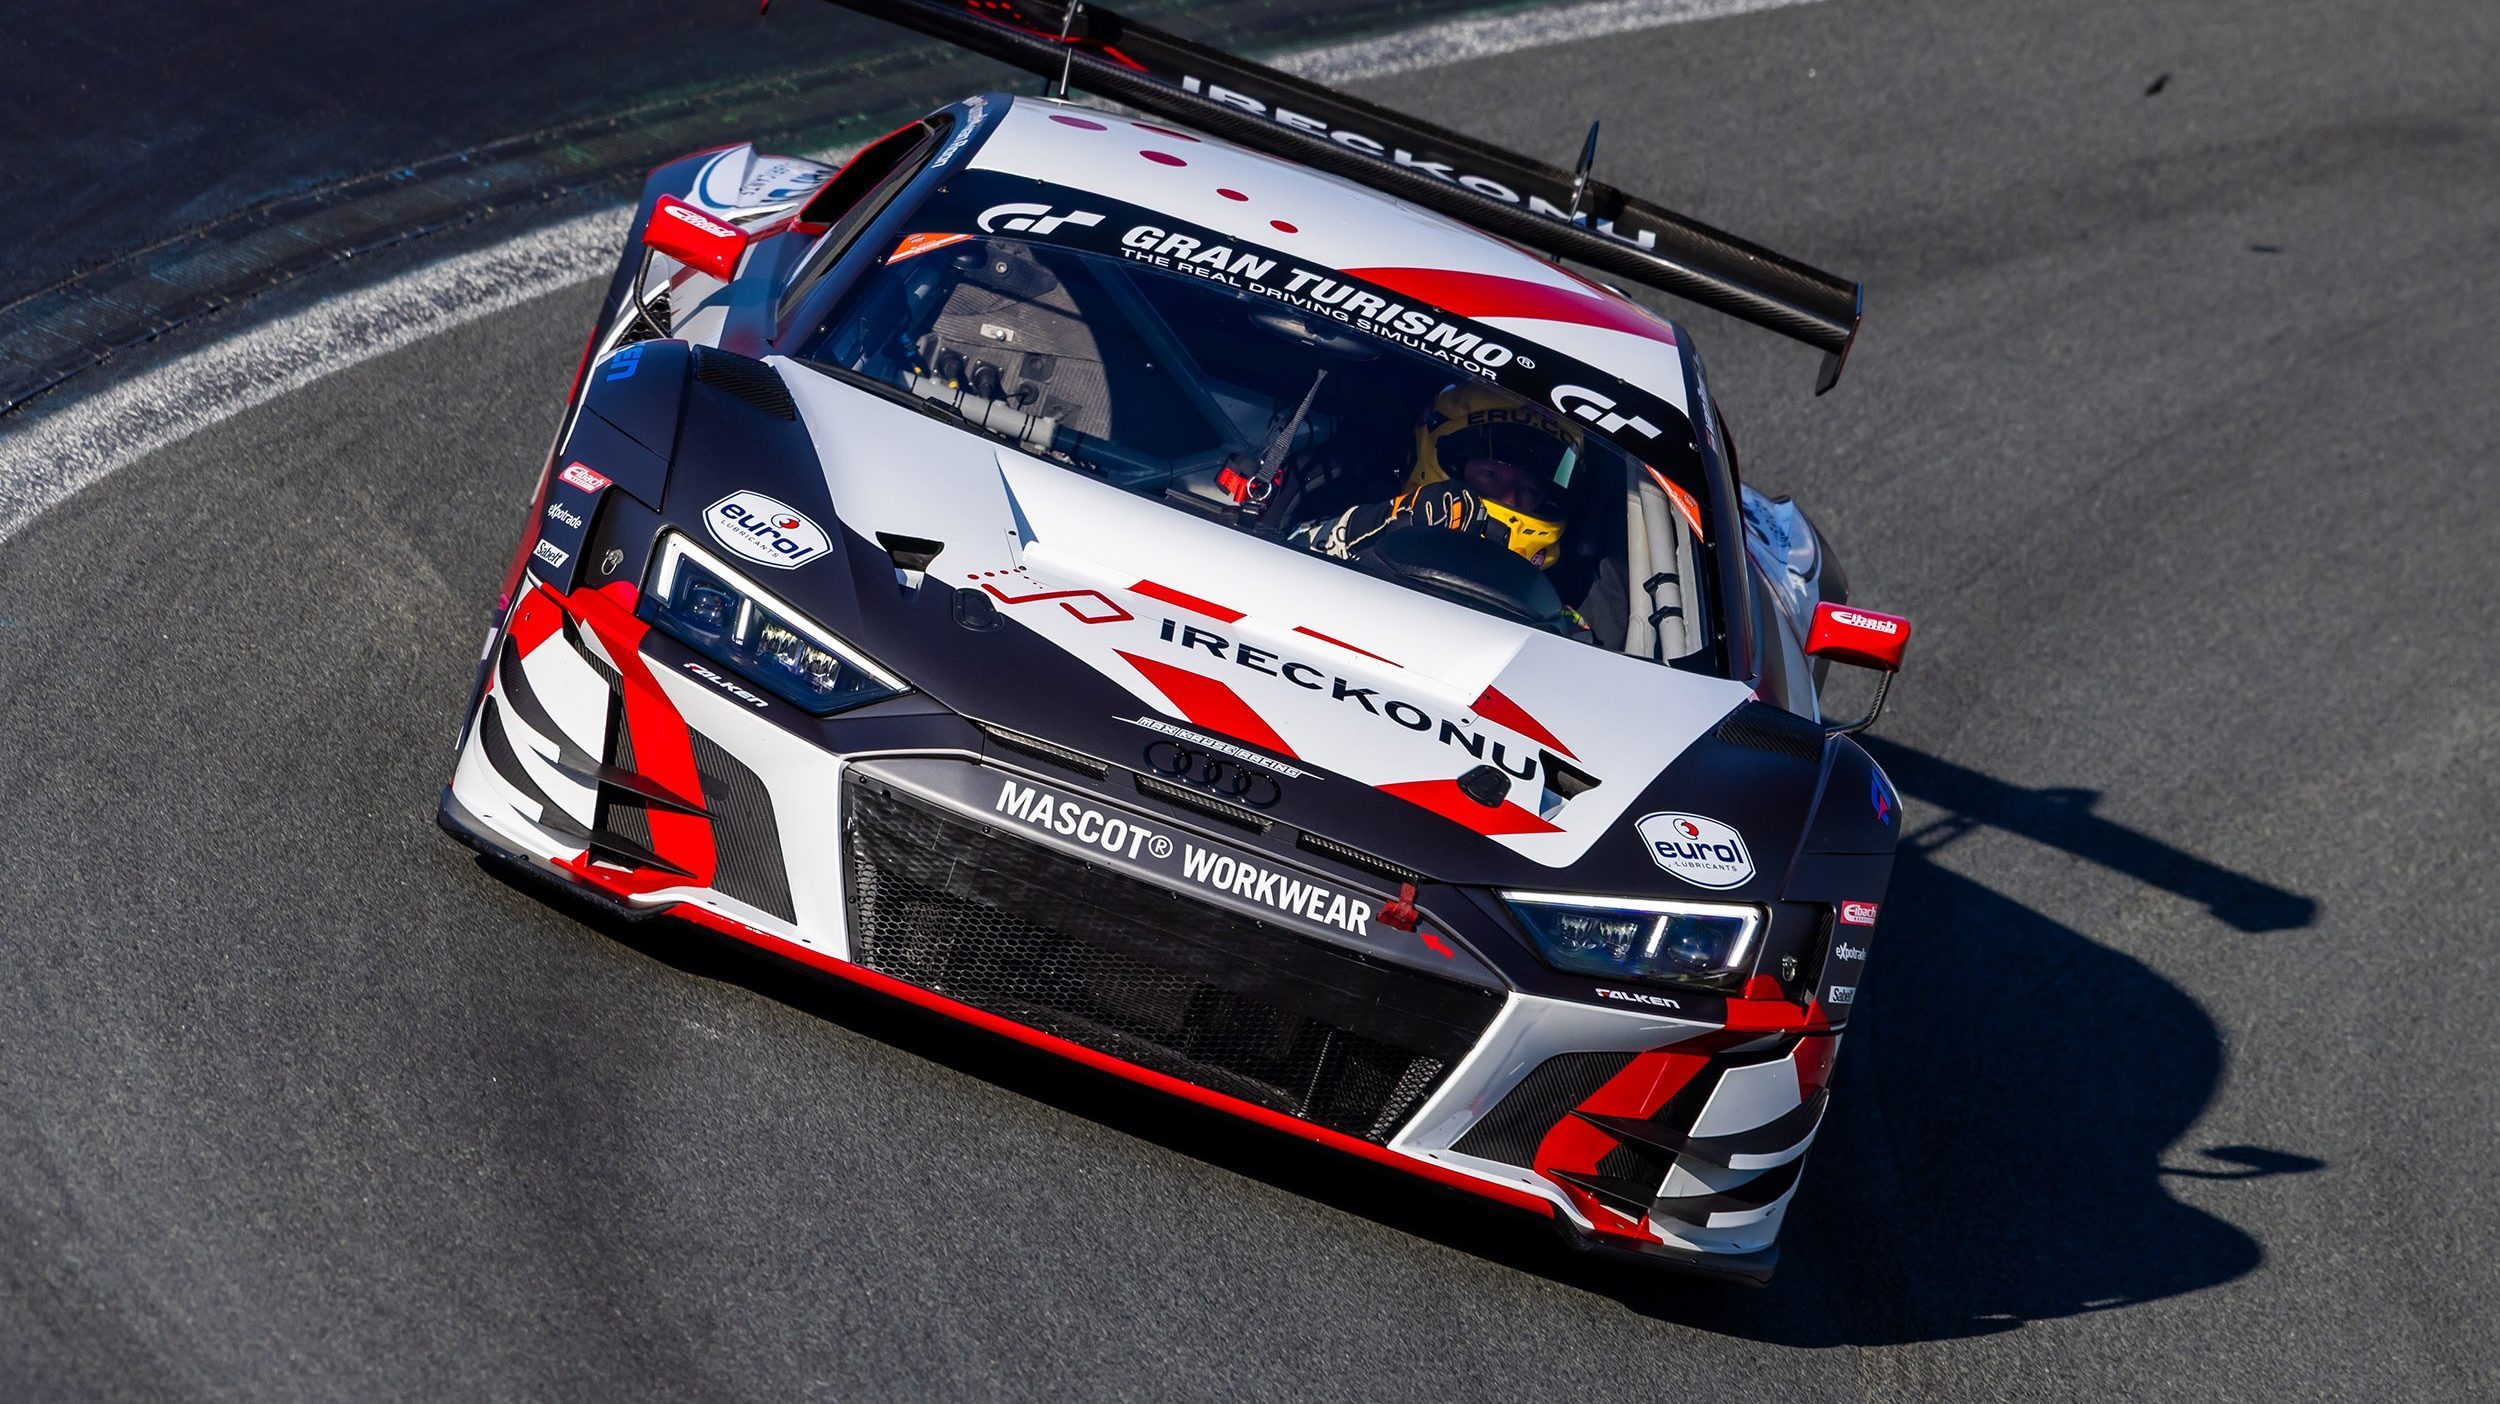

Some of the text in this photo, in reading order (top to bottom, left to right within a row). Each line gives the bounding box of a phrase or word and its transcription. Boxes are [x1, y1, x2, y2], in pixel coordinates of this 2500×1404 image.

[1122, 226, 1277, 280] GRAN
[1120, 247, 1498, 381] THE REAL DRIVING SIMULATOR
[536, 541, 563, 565] Sabelt
[720, 503, 814, 560] eurol
[721, 519, 780, 558] LUBRICANTS
[683, 663, 769, 708] FALKEN
[1159, 617, 1538, 782] IRECKONU
[1138, 716, 1178, 736] MAX
[1235, 748, 1301, 778] RACING
[1655, 839, 1744, 864] eurol
[1674, 861, 1738, 872] LUBRICANTS
[1183, 843, 1372, 937] WORKWEAR
[1595, 988, 1681, 1009] FALKEN
